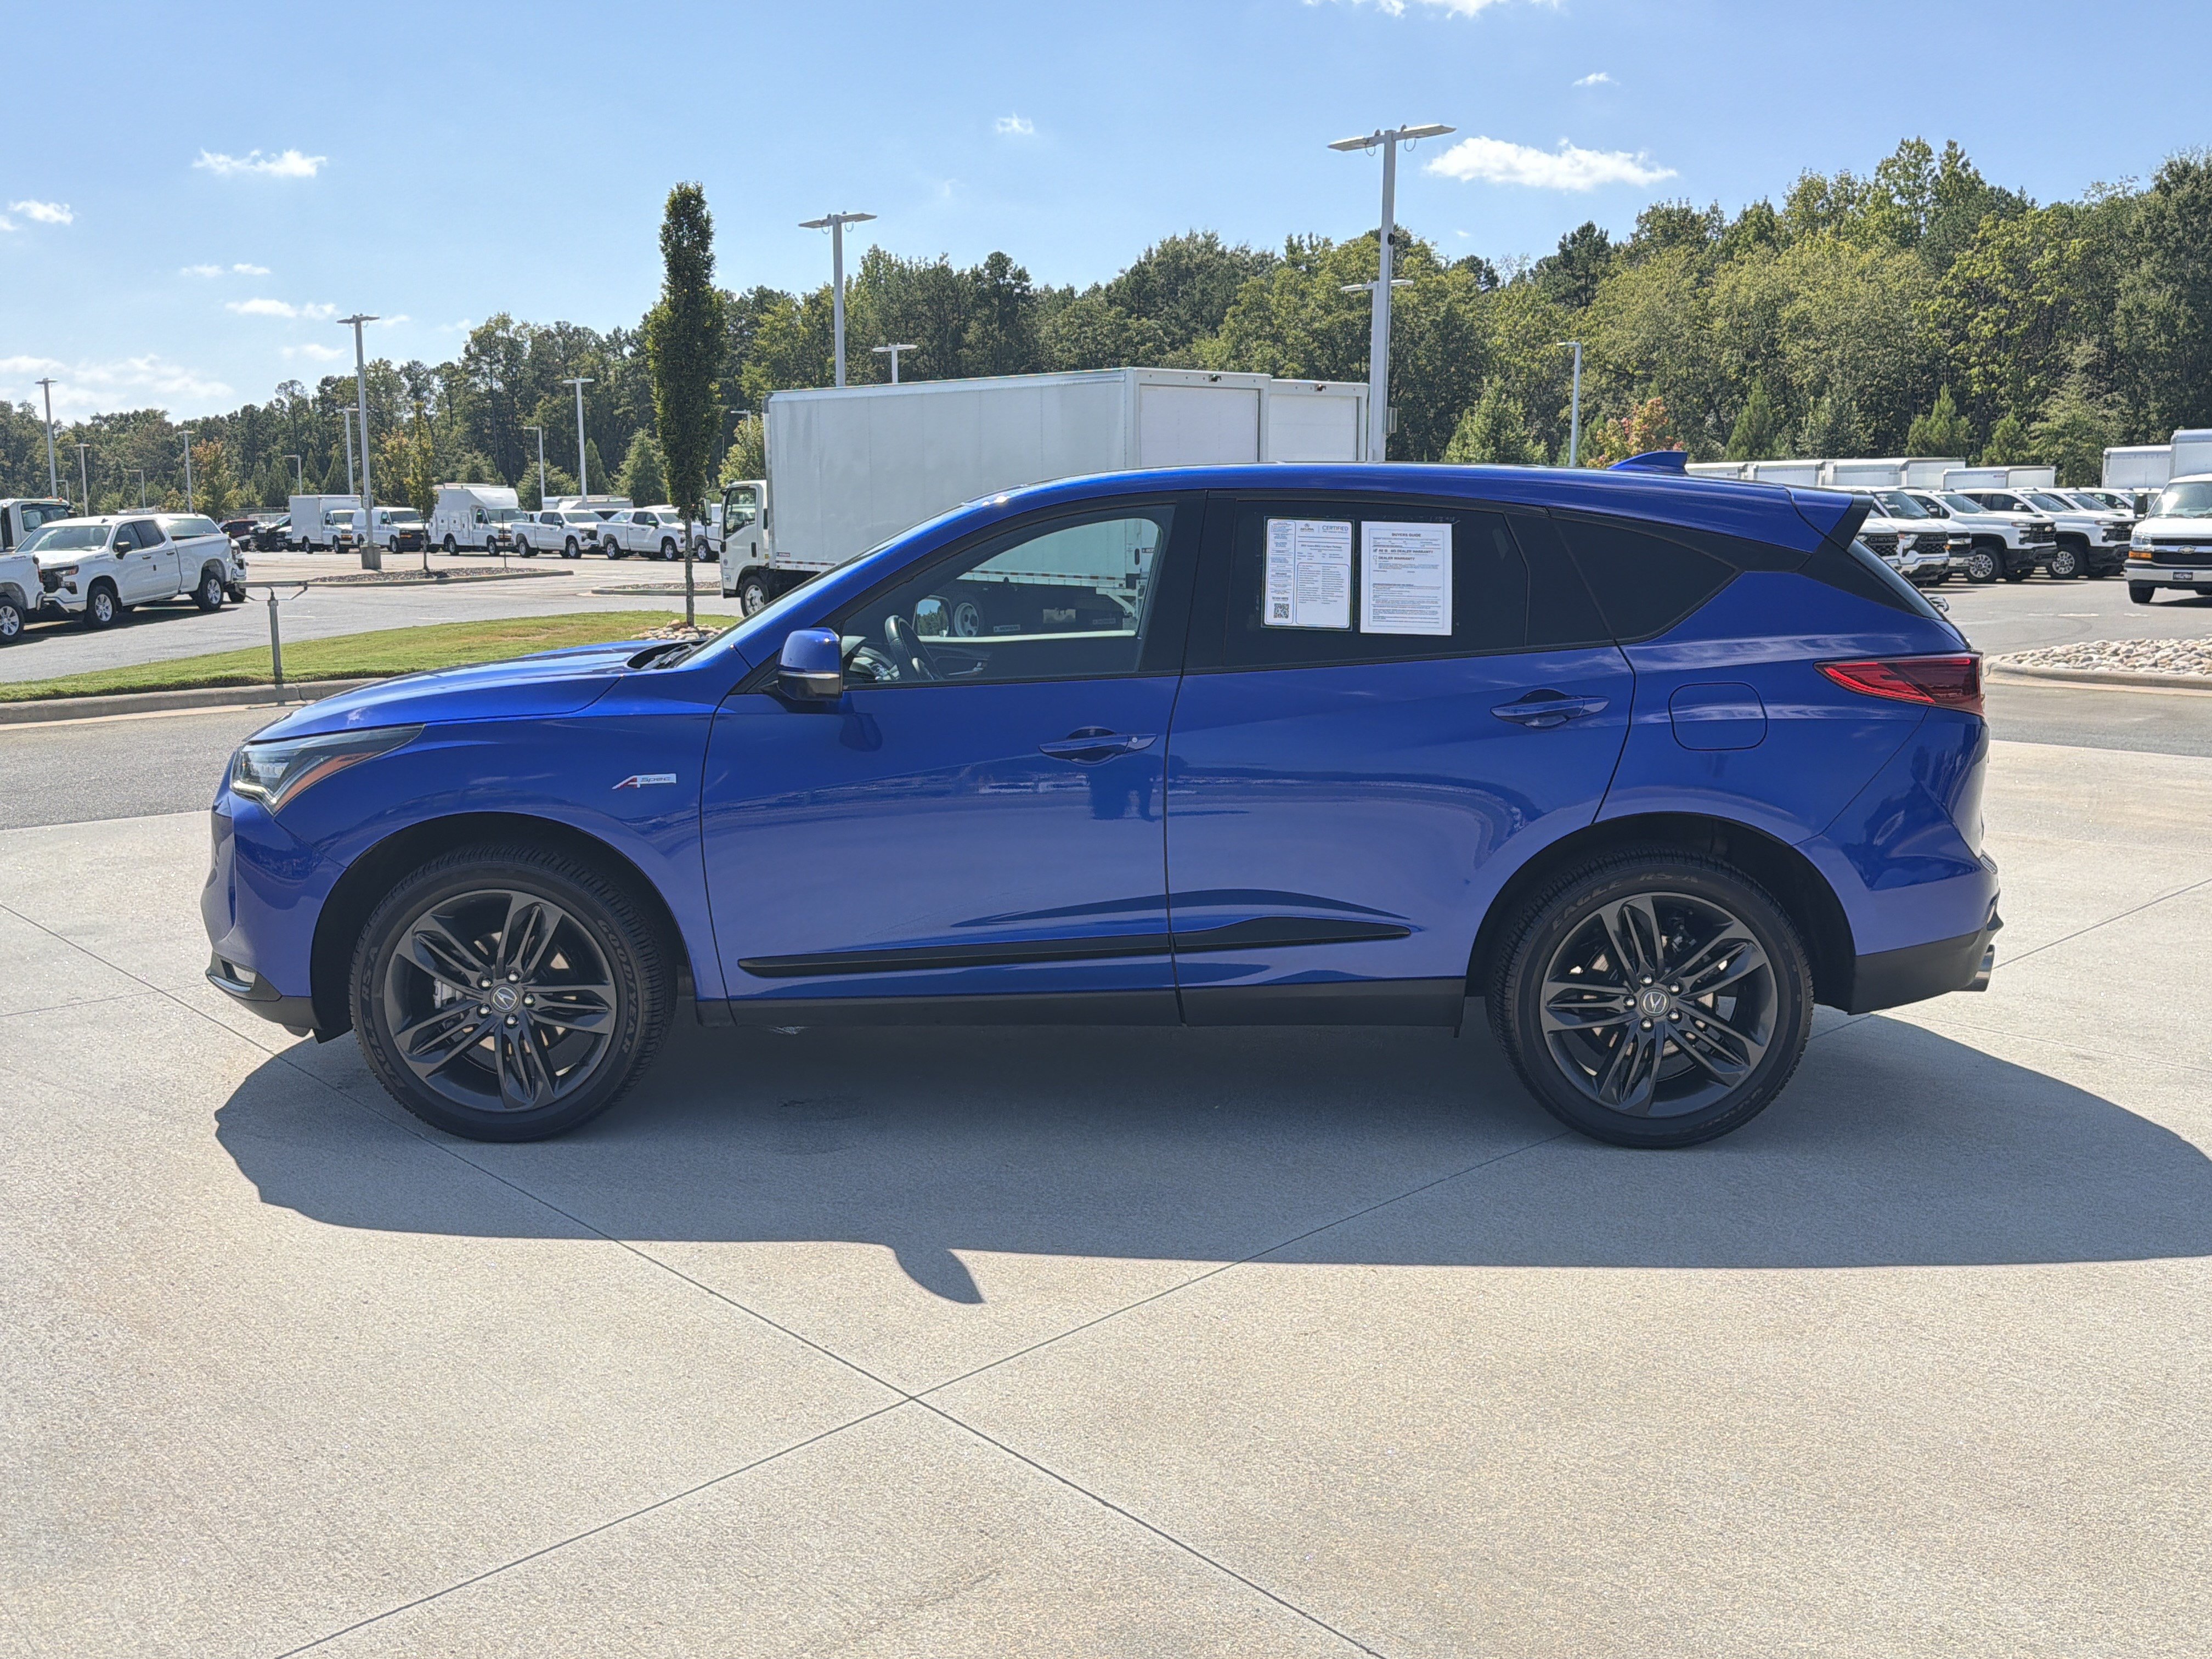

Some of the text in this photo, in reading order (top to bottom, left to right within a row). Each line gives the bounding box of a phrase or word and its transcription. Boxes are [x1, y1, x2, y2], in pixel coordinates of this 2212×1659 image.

[1552, 878, 1623, 930] EAGLE
[597, 919, 636, 1053] GOODYEAR
[364, 1014, 406, 1087] EAGLE
